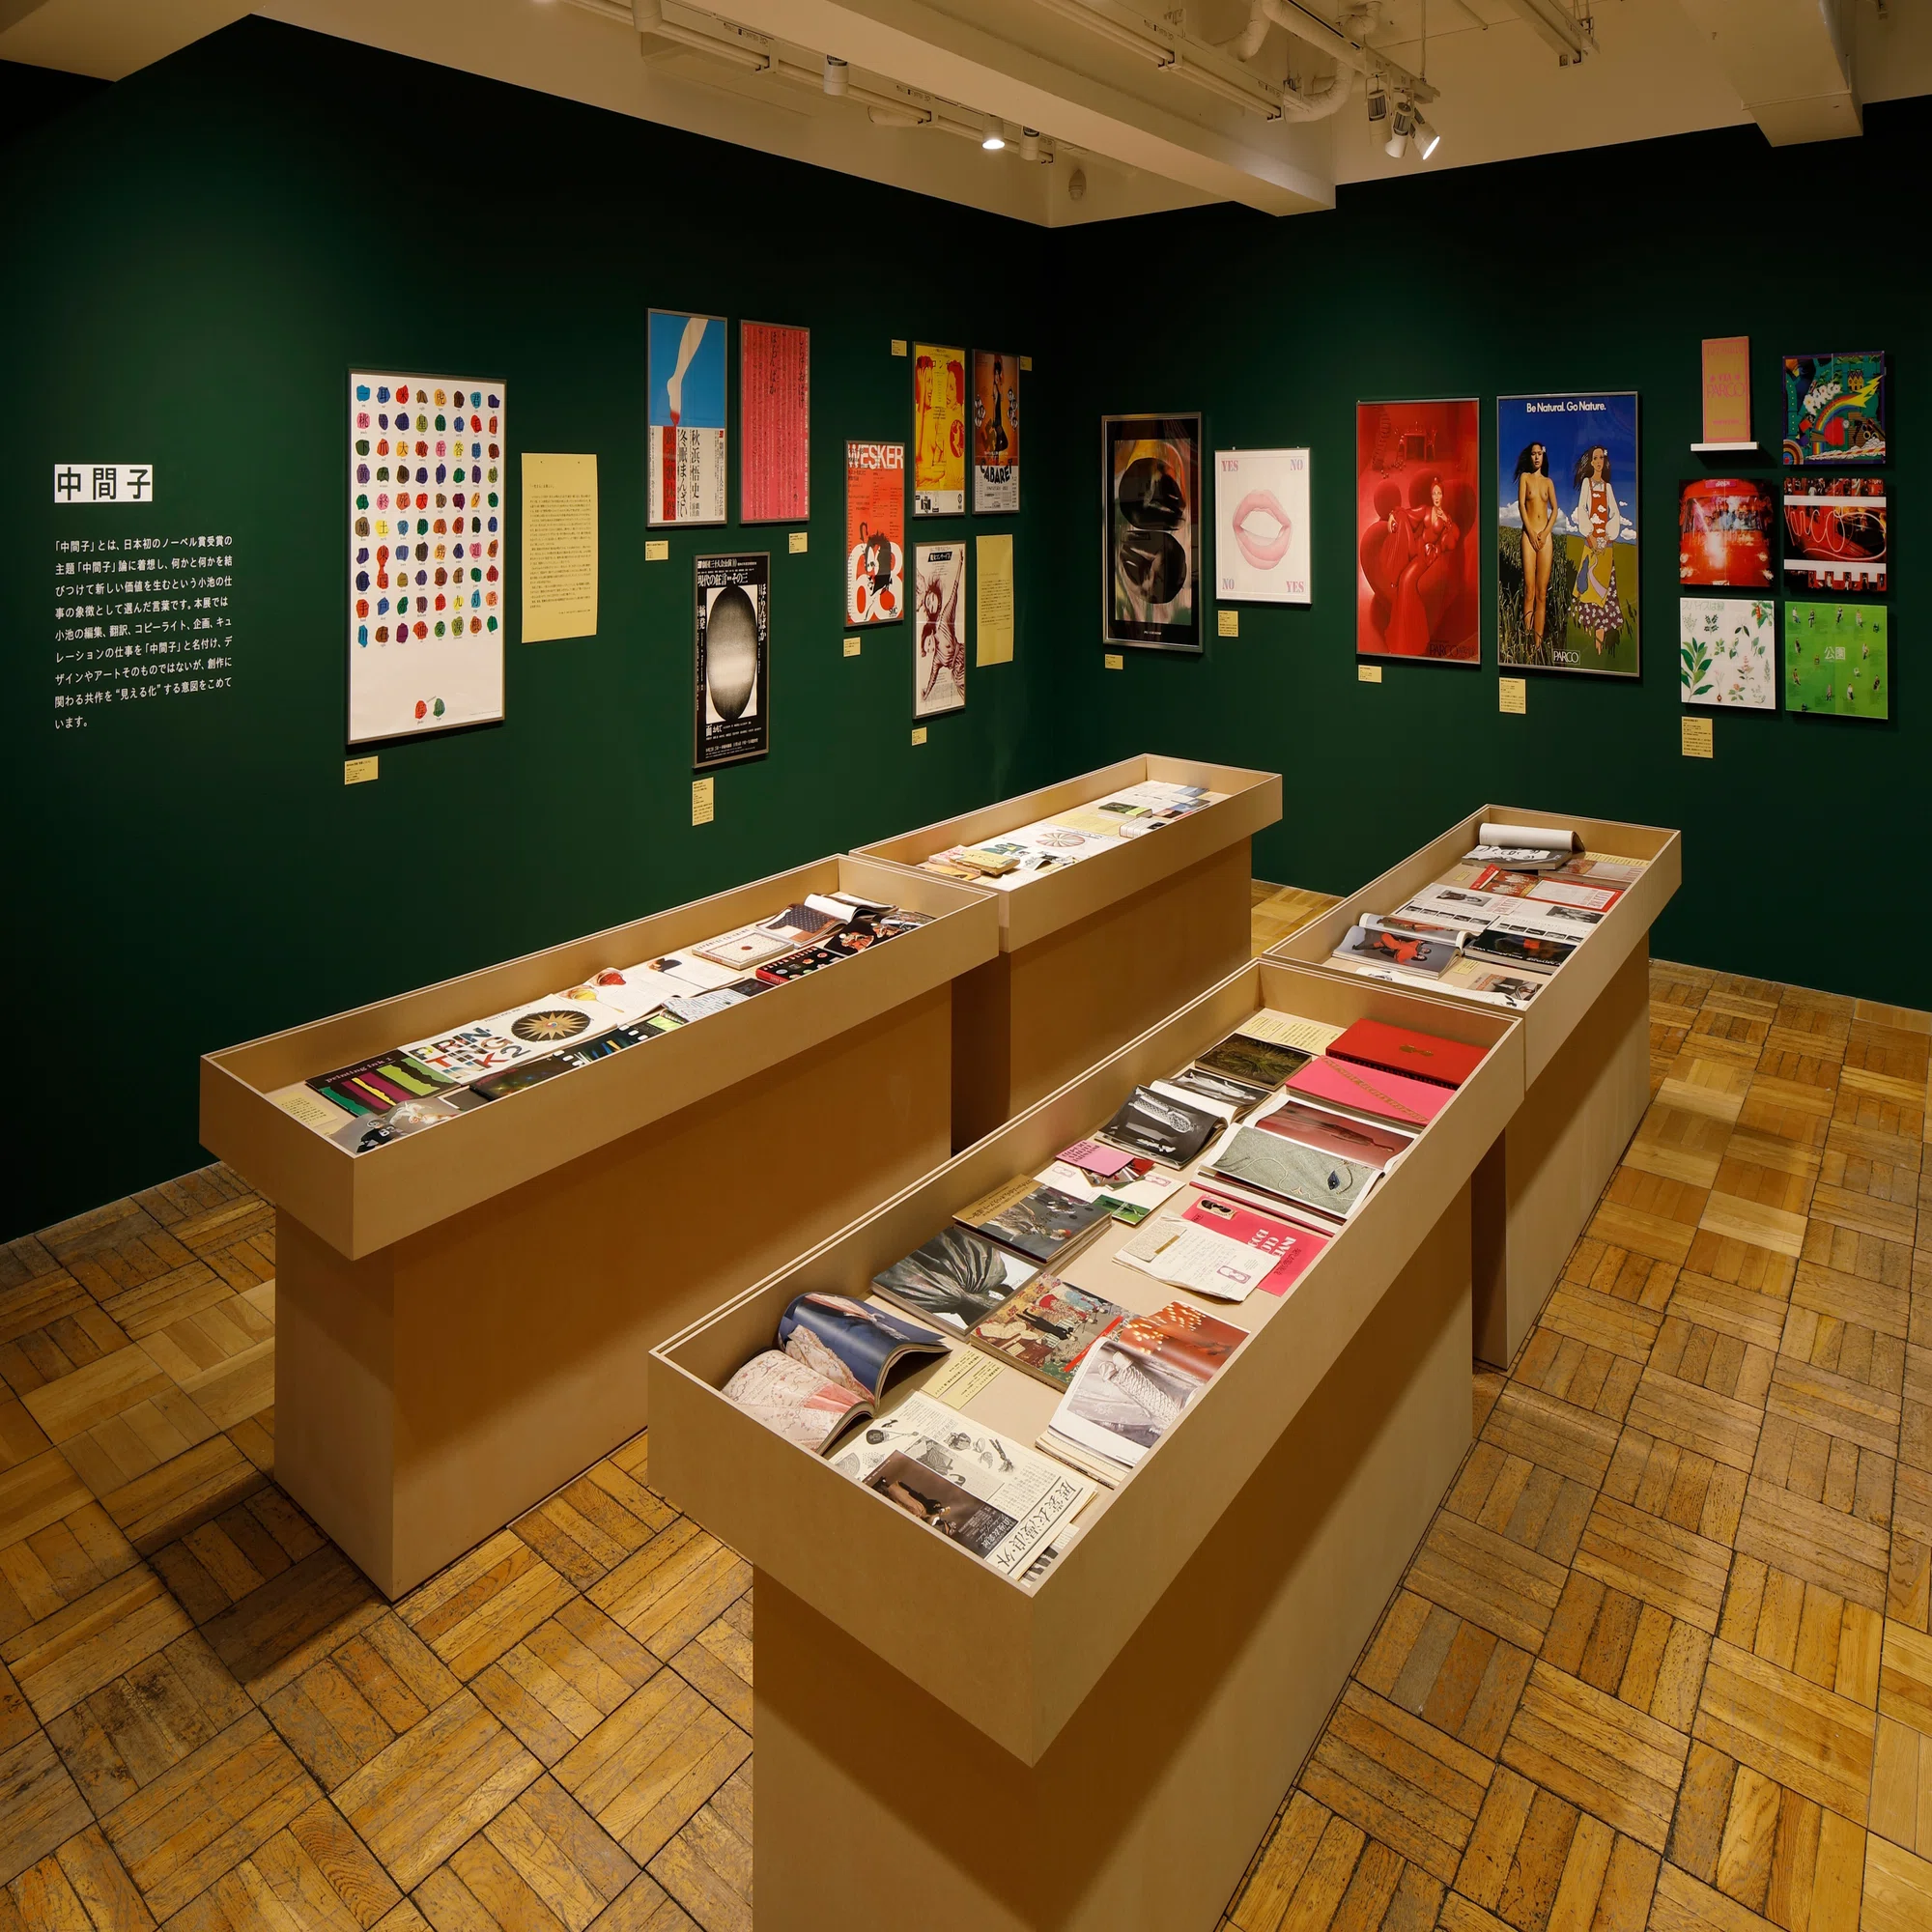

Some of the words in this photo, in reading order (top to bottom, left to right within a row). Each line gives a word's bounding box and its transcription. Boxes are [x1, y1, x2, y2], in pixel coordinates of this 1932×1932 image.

[1707, 383, 1746, 398] PARCO
[1526, 402, 1536, 412] Be
[1537, 402, 1565, 412] Natural.
[1566, 401, 1578, 412] Go
[1578, 401, 1606, 412] Nature.
[847, 443, 904, 469] WESKER
[980, 458, 1013, 484] CABARET
[1221, 460, 1239, 472] YES
[1290, 459, 1303, 471] NO
[57, 467, 151, 500] 中間子
[55, 535, 233, 554] 「中間子」とは、日本初のノーベル賞受賞の
[55, 555, 233, 576] 主題「中間子」論に着想し、何かと何かを結
[55, 576, 233, 597] びつけて新しい価値を生むという小池の仕
[1222, 579, 1236, 590] NO
[1286, 581, 1304, 593] YES
[55, 596, 229, 620] 事の象徴として選んだ言葉です。本展では
[1553, 650, 1579, 664] PARCO
[1825, 646, 1846, 660] 公園
[55, 716, 88, 730] います。
[499, 1044, 531, 1059] 2
